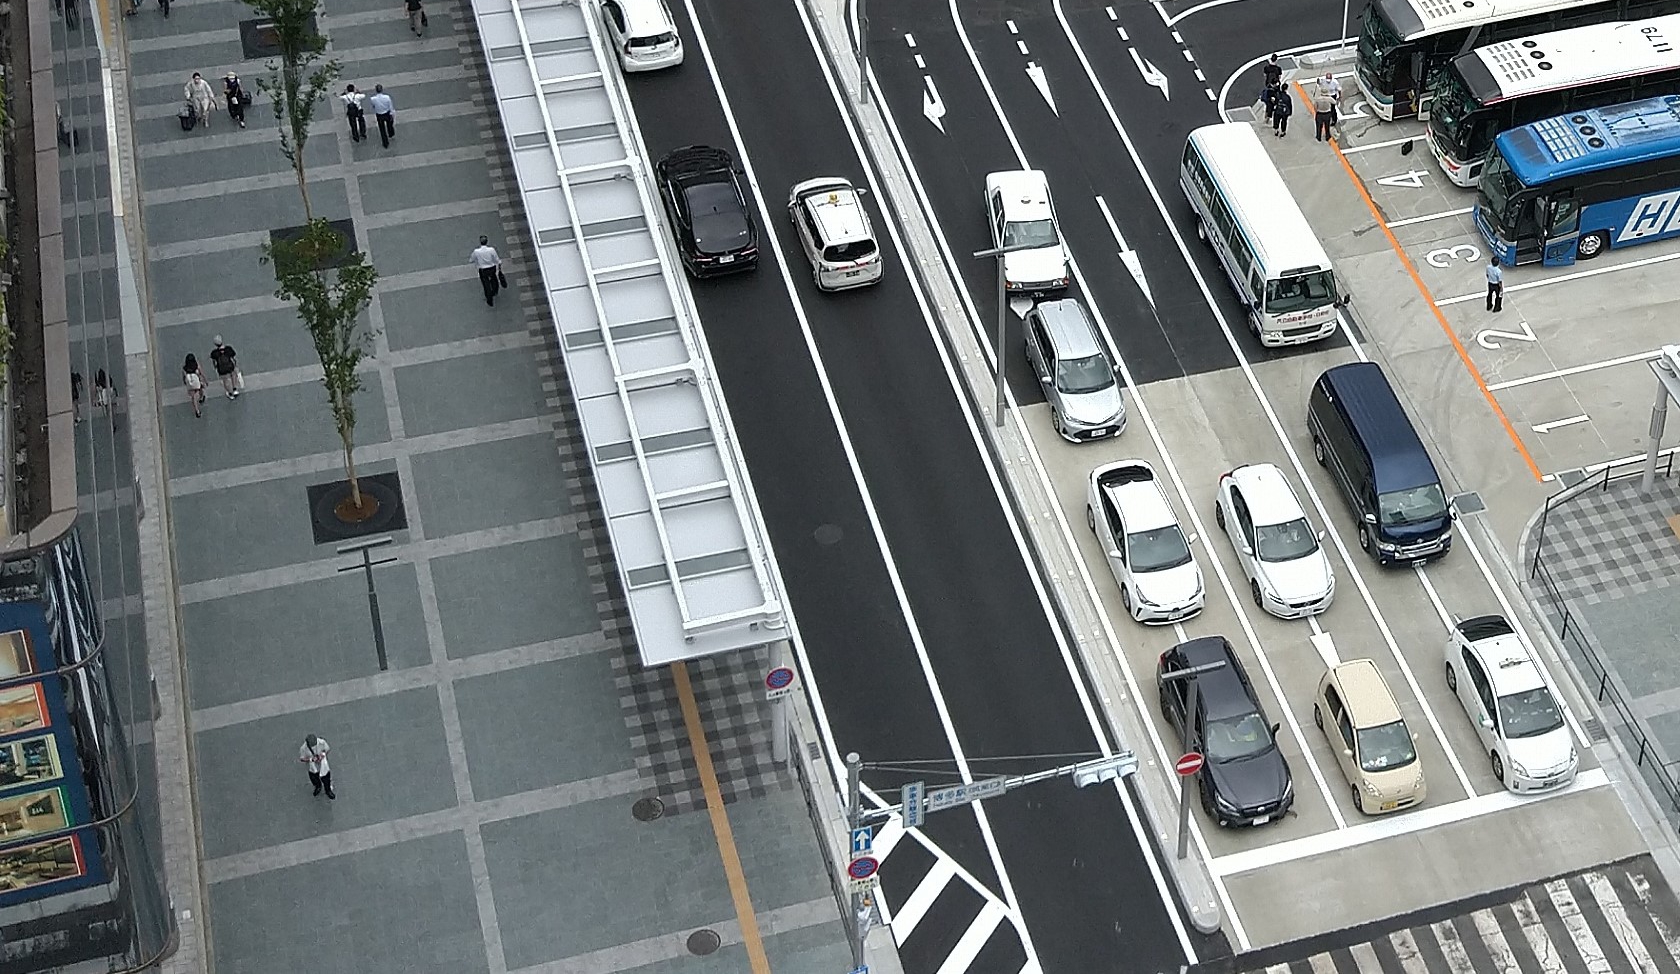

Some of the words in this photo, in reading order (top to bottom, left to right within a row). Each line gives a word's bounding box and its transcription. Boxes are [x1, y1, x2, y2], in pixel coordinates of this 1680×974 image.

[1640, 26, 1673, 53] 1179
[1376, 169, 1430, 188] 4
[1425, 244, 1481, 268] 3
[1476, 320, 1537, 350] 2
[1531, 413, 1590, 435] 1
